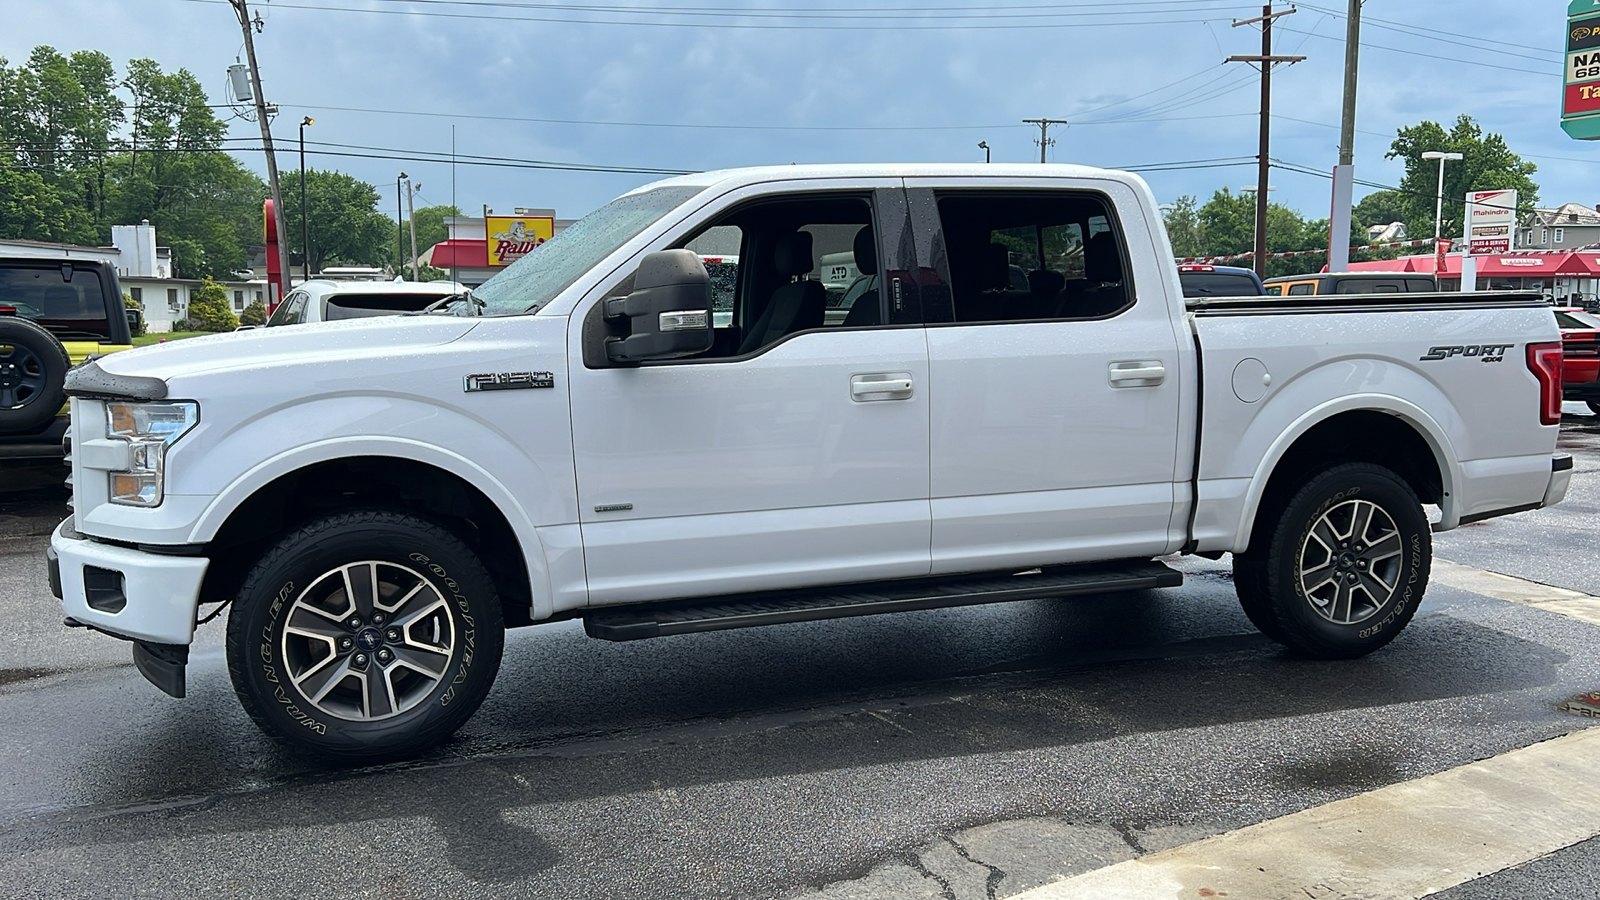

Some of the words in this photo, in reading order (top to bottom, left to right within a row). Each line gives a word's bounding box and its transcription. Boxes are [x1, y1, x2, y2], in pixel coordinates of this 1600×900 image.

[1473, 209, 1509, 217] Mahindra
[1419, 343, 1515, 362] SPORT
[409, 552, 477, 707] GOODYEAR
[1359, 533, 1421, 639] WRANGLER
[260, 580, 327, 736] WRANGLER
